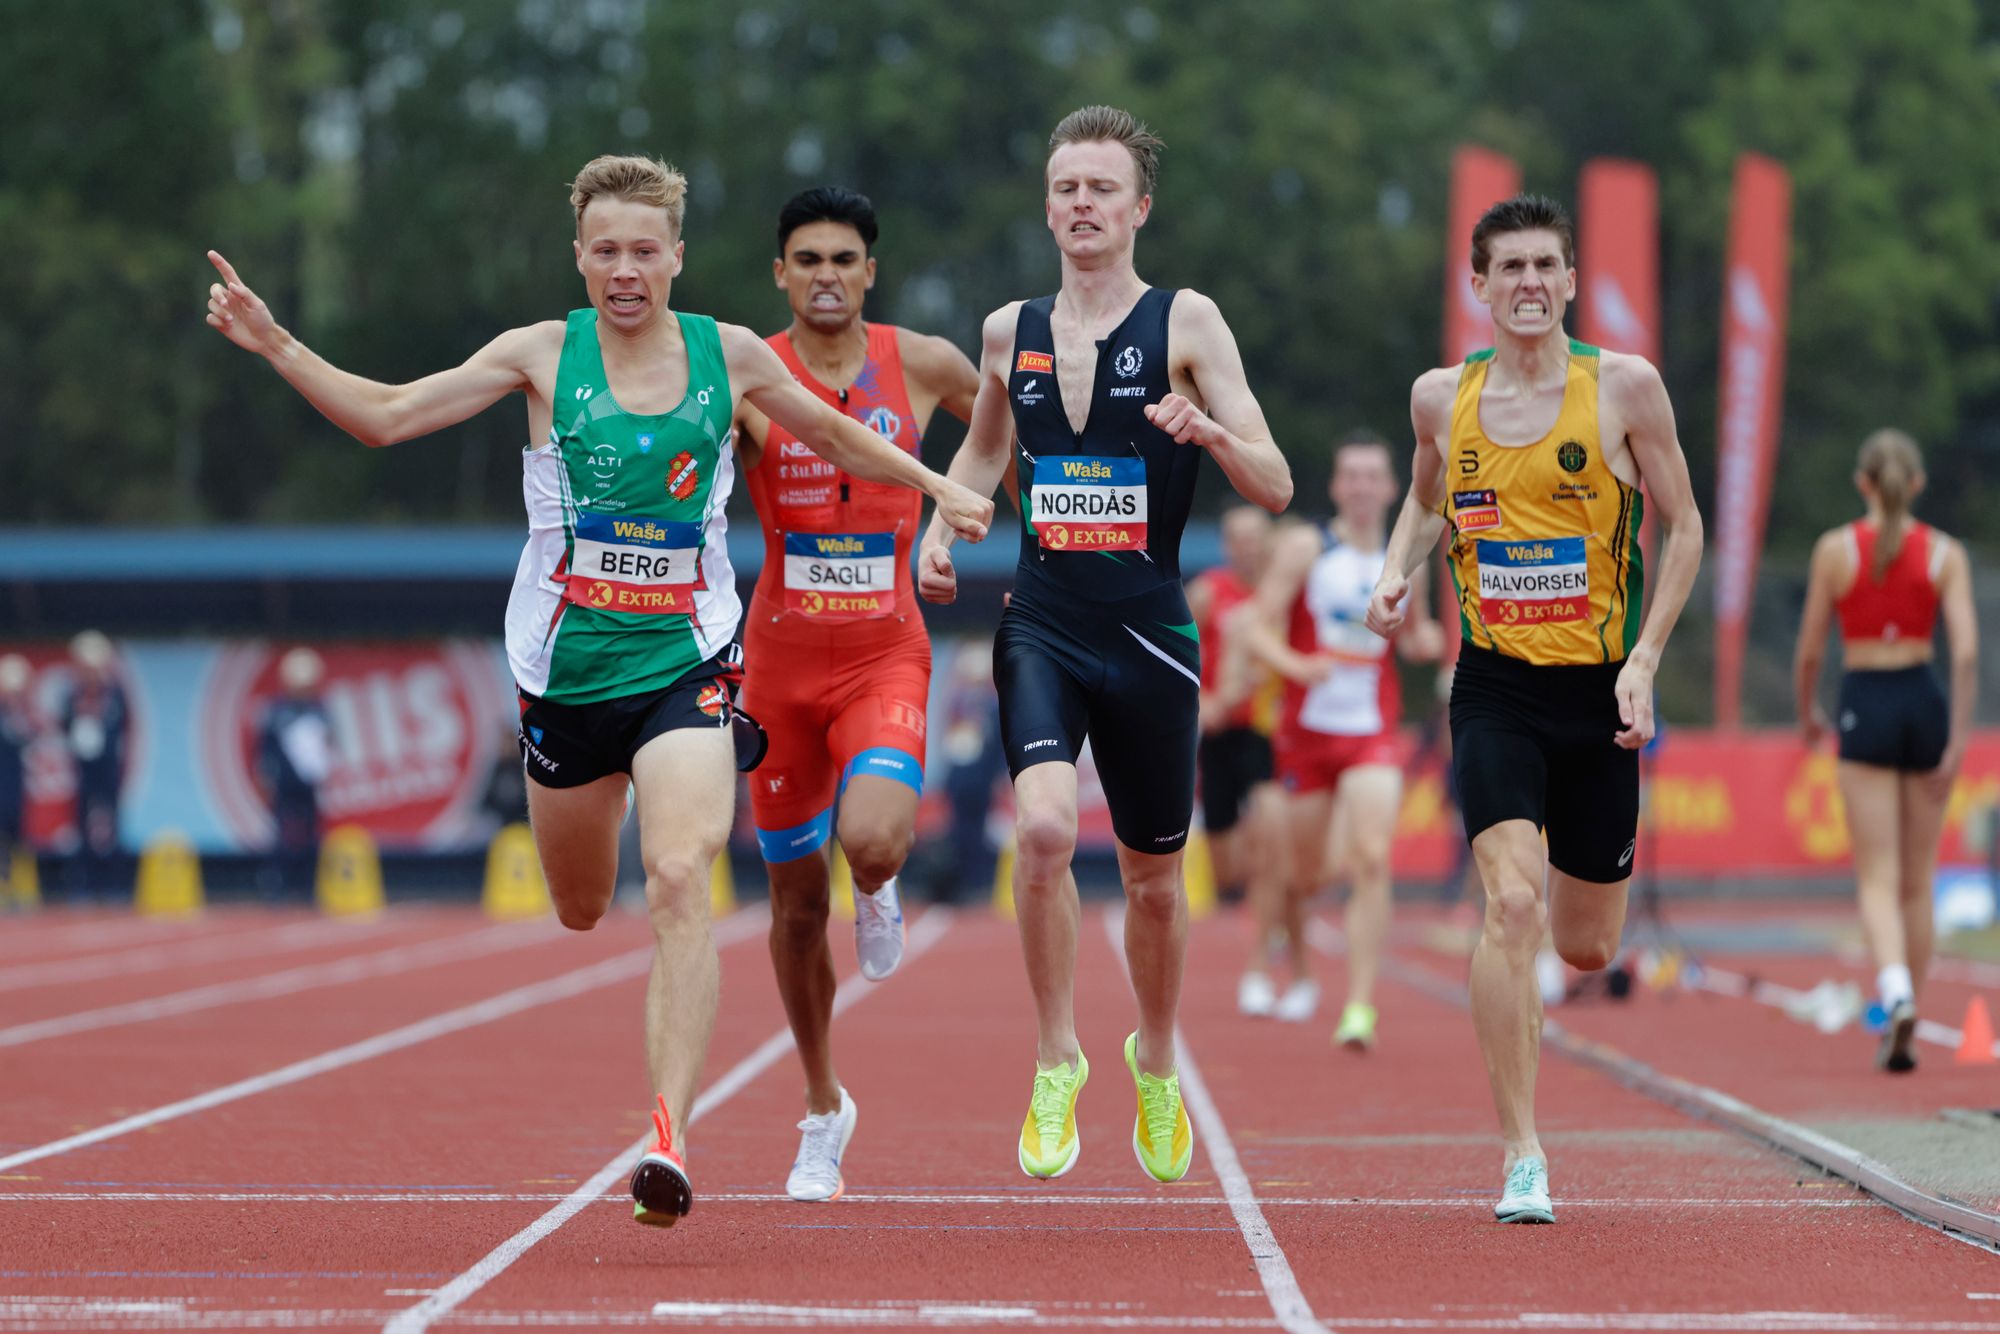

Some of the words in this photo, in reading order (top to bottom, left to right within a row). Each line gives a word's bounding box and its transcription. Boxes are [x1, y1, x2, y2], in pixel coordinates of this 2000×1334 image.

[1028, 357, 1050, 369] EXTRA
[1110, 387, 1146, 397] TRIMTEX
[587, 456, 621, 467] ALTI
[1062, 461, 1111, 478] Wasa
[1041, 488, 1136, 515] NORDÅS
[1469, 512, 1496, 524] EXTRA
[613, 521, 666, 541] Wasa
[1074, 530, 1130, 544] EXTRA
[816, 537, 865, 553] Wasa
[1505, 544, 1554, 561] Wasa
[601, 551, 670, 578] BERG
[809, 565, 872, 585] SAGLI
[1482, 571, 1587, 592] HALVORSEN
[618, 591, 675, 606] EXTRA
[828, 597, 879, 610] EXTRA
[1524, 603, 1576, 618] EXTRA
[518, 731, 560, 772] TRIMTEX
[1024, 740, 1058, 752] TRIMTEX
[1155, 831, 1185, 842] TRIMTEX
